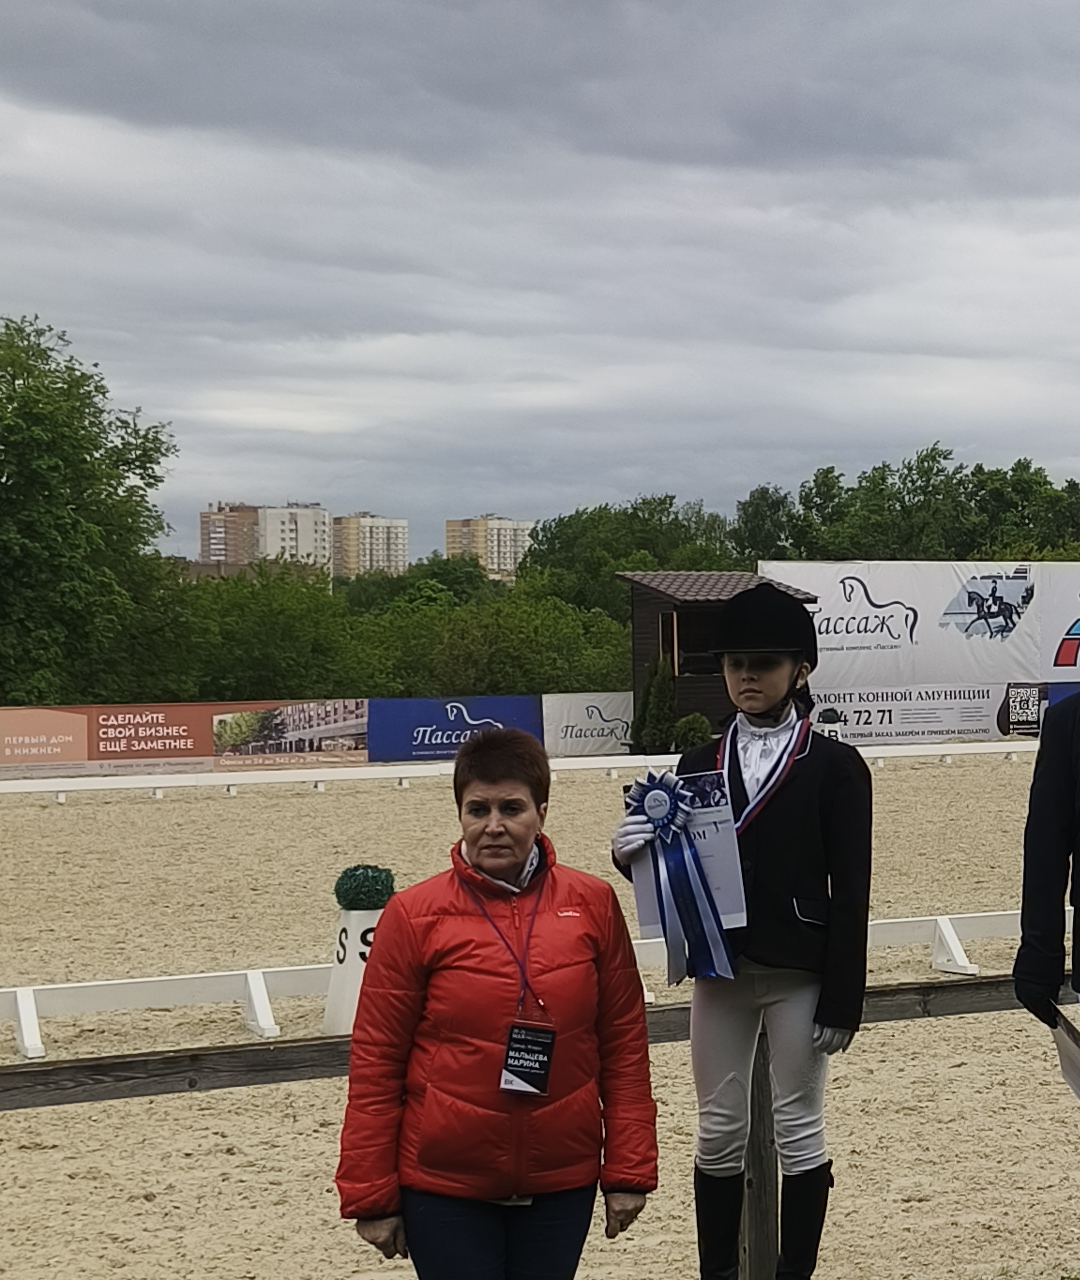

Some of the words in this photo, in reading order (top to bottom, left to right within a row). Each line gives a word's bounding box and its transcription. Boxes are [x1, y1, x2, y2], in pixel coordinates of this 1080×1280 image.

[858, 688, 912, 703] КОННОЙ
[915, 688, 990, 703] АМУНИЦИИ
[99, 711, 166, 725] СДЕЛАЙТЕ
[853, 709, 873, 726] 72
[876, 709, 893, 725] 71
[99, 725, 135, 739] СВОЙ
[138, 726, 188, 737] БИЗНЕС
[412, 724, 478, 745] Пасса
[560, 723, 622, 741] Пассаж
[4, 735, 47, 744] ПЕРВЫЙ
[50, 735, 73, 744] ДОМ
[99, 739, 128, 752] ЕЩЁ
[131, 738, 194, 752] ЗАМЕТНЕЕ
[5, 748, 11, 756] В
[14, 746, 61, 755] НИЖНЕМ
[336, 926, 348, 965] S
[507, 1057, 540, 1068] МАРИНА
[508, 1050, 548, 1062] МАЛЬЦЕВА
